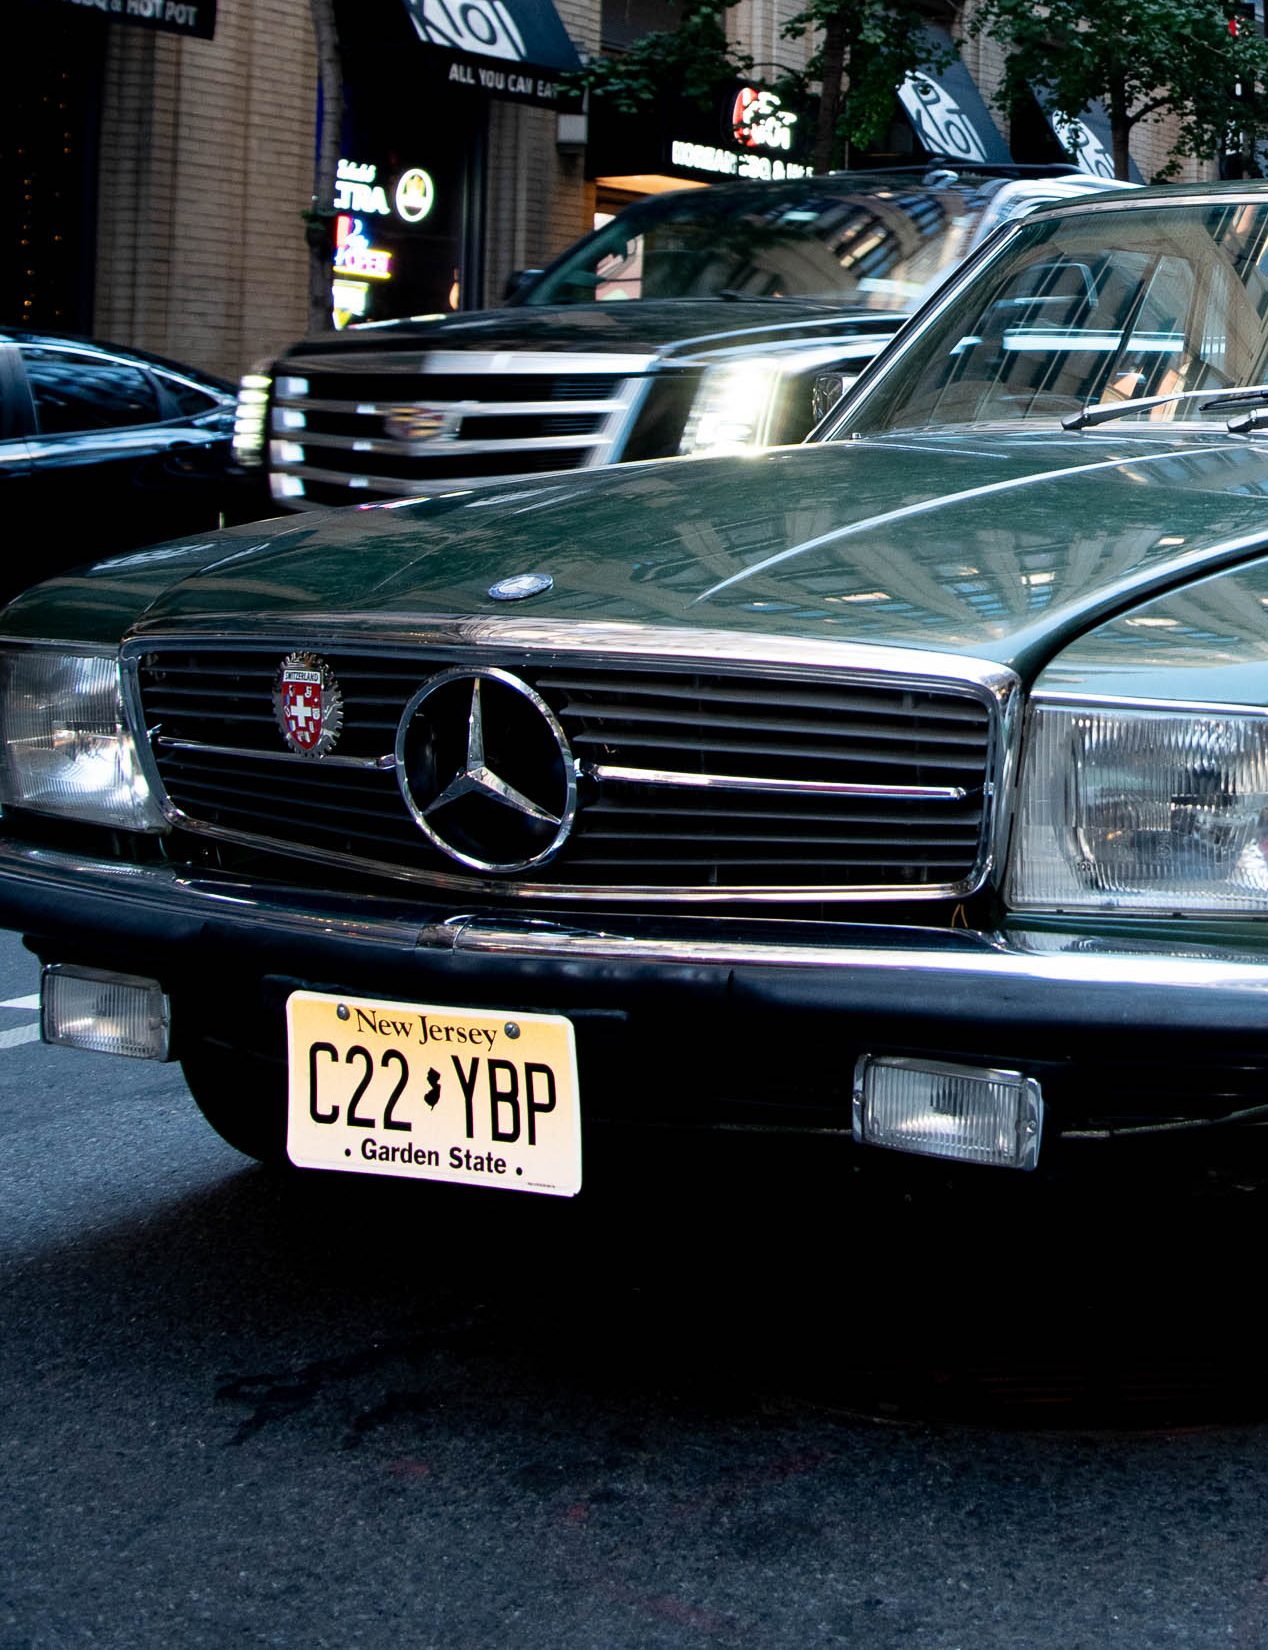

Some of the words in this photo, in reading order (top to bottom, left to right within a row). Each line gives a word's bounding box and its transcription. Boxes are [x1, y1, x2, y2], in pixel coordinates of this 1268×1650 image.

[165, 1, 198, 27] POT
[448, 62, 476, 84] ALL
[478, 68, 506, 90] YOU
[507, 73, 533, 94] CAN
[285, 671, 319, 682] SWITZERLAND
[355, 1008, 413, 1039] New
[418, 1014, 498, 1052] Jersey
[309, 1041, 413, 1133] C22
[450, 1054, 557, 1146] YBP
[361, 1137, 440, 1167] Garden
[449, 1146, 507, 1175] State
